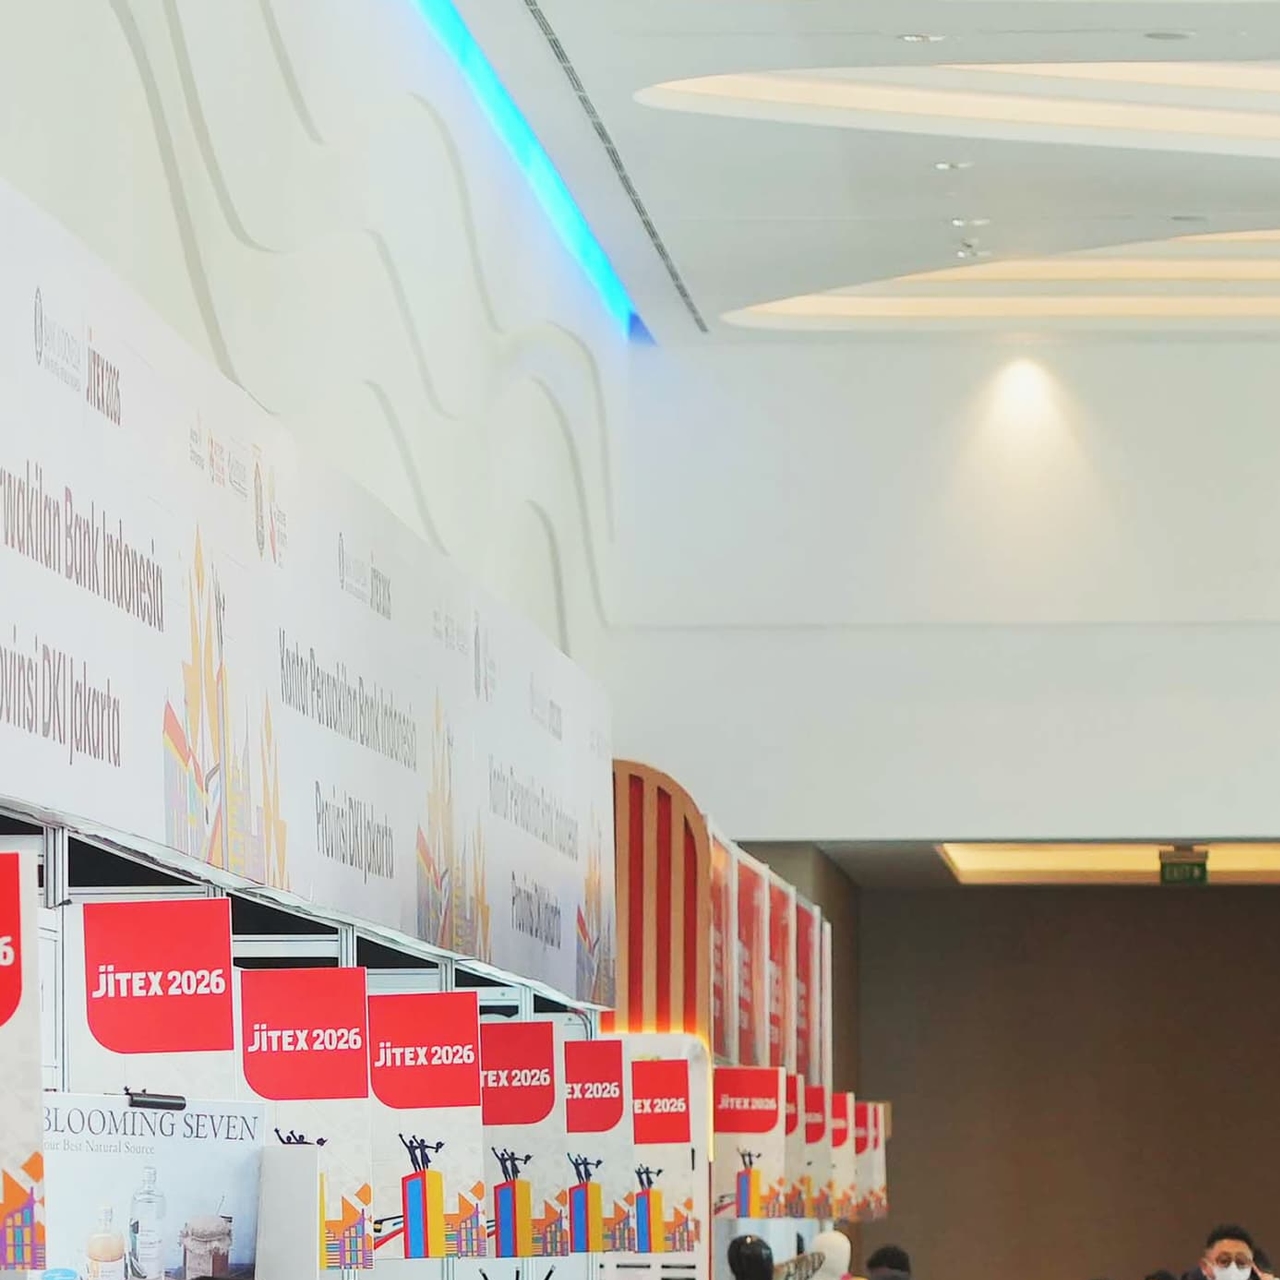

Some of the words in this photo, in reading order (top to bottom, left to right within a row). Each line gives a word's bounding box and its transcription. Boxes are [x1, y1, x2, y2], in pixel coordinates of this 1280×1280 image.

[0, 459, 60, 574] wakilan
[65, 485, 100, 597] Bank
[103, 510, 163, 633] Indonesia
[0, 623, 38, 734] vinsi
[42, 644, 66, 745] DKI
[69, 656, 121, 768] Jakarta
[279, 627, 308, 717] Kantor
[310, 647, 357, 741] Perwakilan
[358, 676, 381, 753] Bank
[381, 687, 417, 772] Indonesia
[315, 781, 348, 865] Provinsi
[349, 797, 363, 870] DKI
[363, 804, 394, 884] Jakarta
[167, 969, 226, 995] 2026
[312, 1027, 362, 1050] 2026
[431, 1044, 475, 1065] 2026
[481, 1070, 508, 1088] TEX
[512, 1069, 551, 1086] 2026
[565, 1084, 583, 1099] EX
[585, 1082, 620, 1098] 2026
[632, 1099, 652, 1114] EX
[653, 1098, 686, 1113] 2026
[44, 1106, 176, 1137] BLOOMING
[183, 1112, 258, 1141] SEVEN
[44, 1141, 59, 1151] our
[63, 1140, 82, 1151] Best
[86, 1140, 122, 1153] Natural
[124, 1142, 155, 1154] Source
